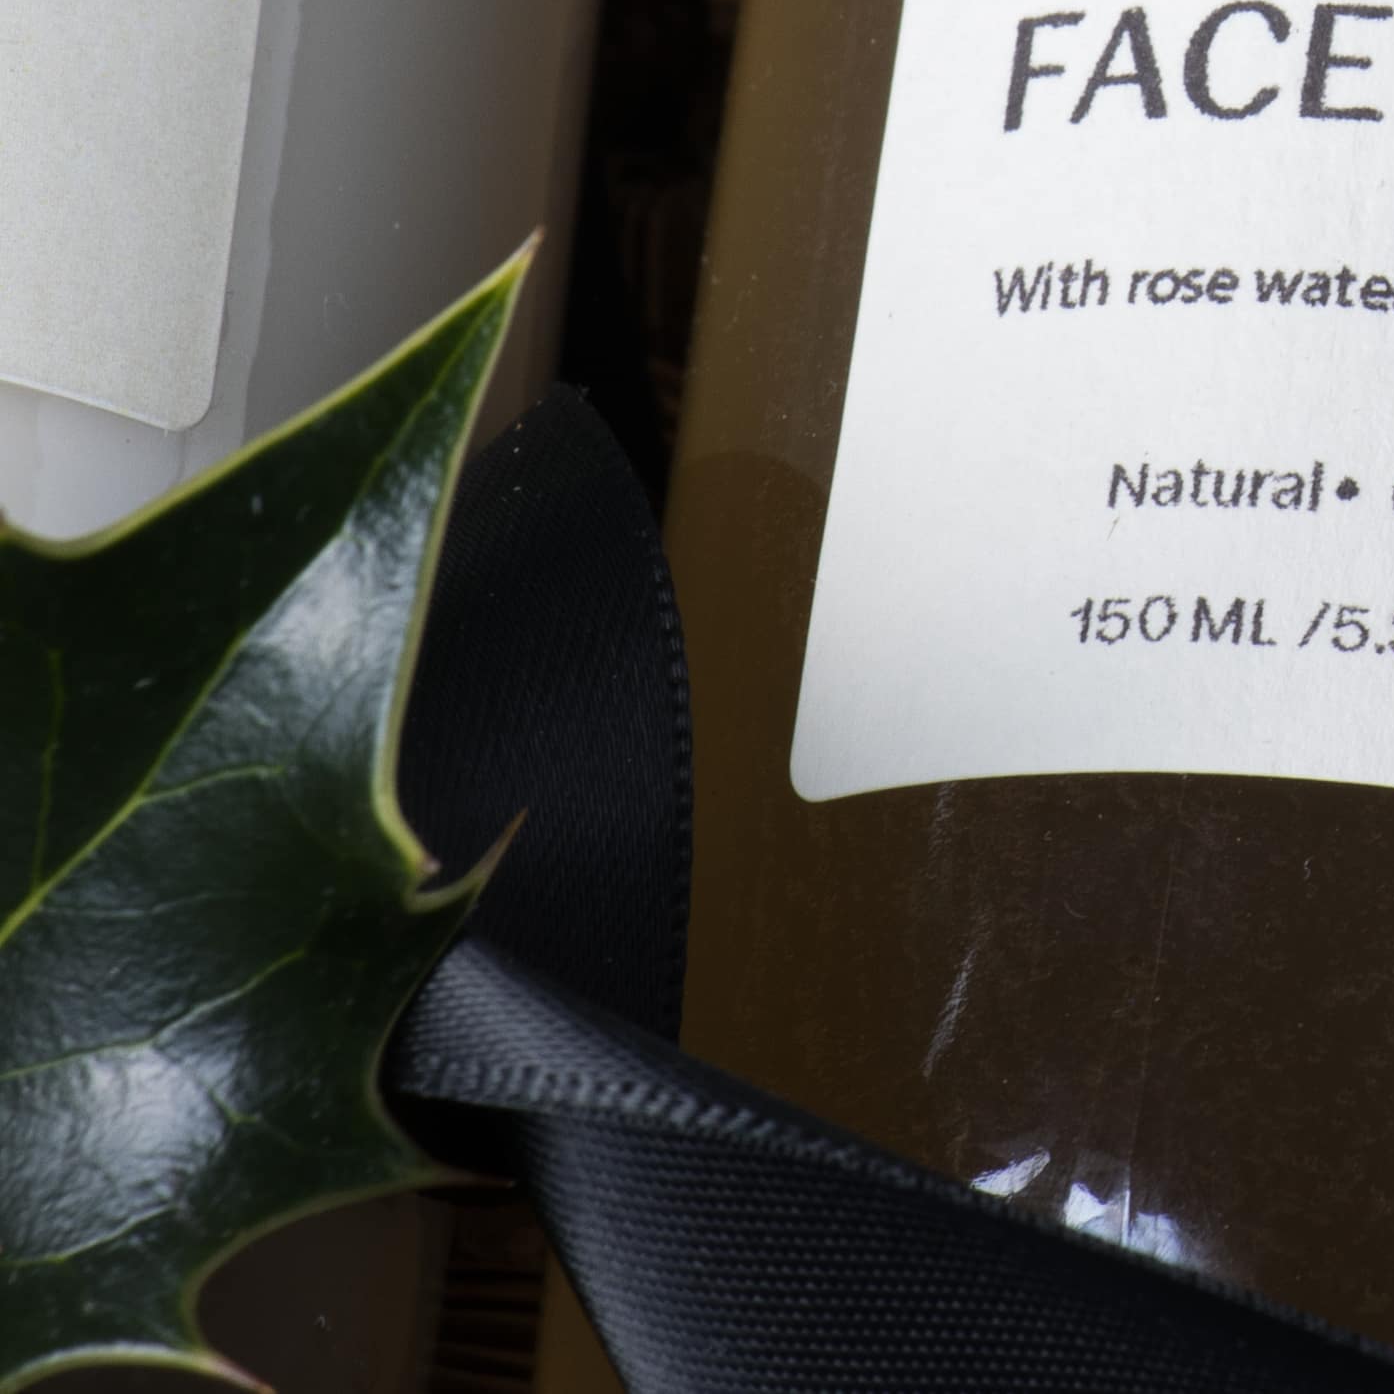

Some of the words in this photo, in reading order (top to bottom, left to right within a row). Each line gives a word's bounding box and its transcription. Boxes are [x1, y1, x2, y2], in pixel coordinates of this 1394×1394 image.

[991, 259, 1110, 318] With
[1127, 262, 1240, 308] rose
[1069, 594, 1180, 646] 150
[1190, 598, 1277, 649] ML
